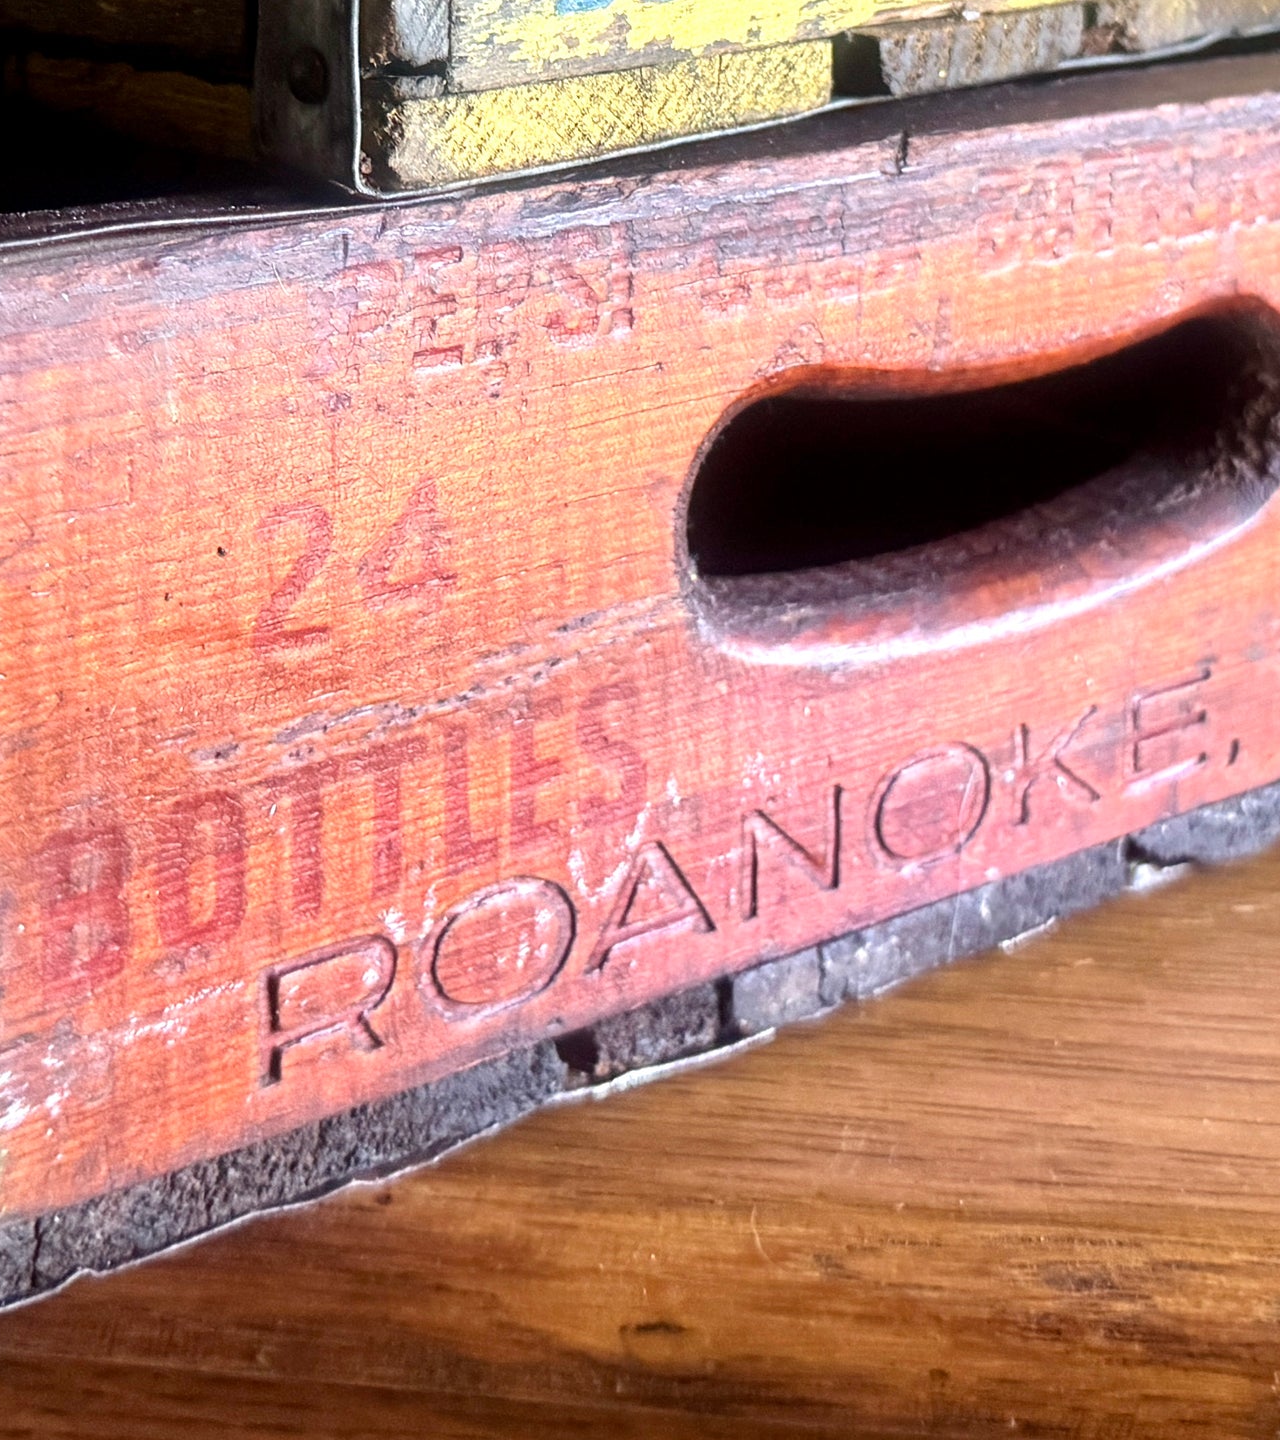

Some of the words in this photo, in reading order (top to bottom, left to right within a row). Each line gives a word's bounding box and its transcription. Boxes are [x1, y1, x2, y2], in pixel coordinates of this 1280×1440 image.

[250, 472, 460, 662] 24
[38, 680, 650, 990] BOTTLES
[258, 656, 1240, 1089] ROANOKE,
